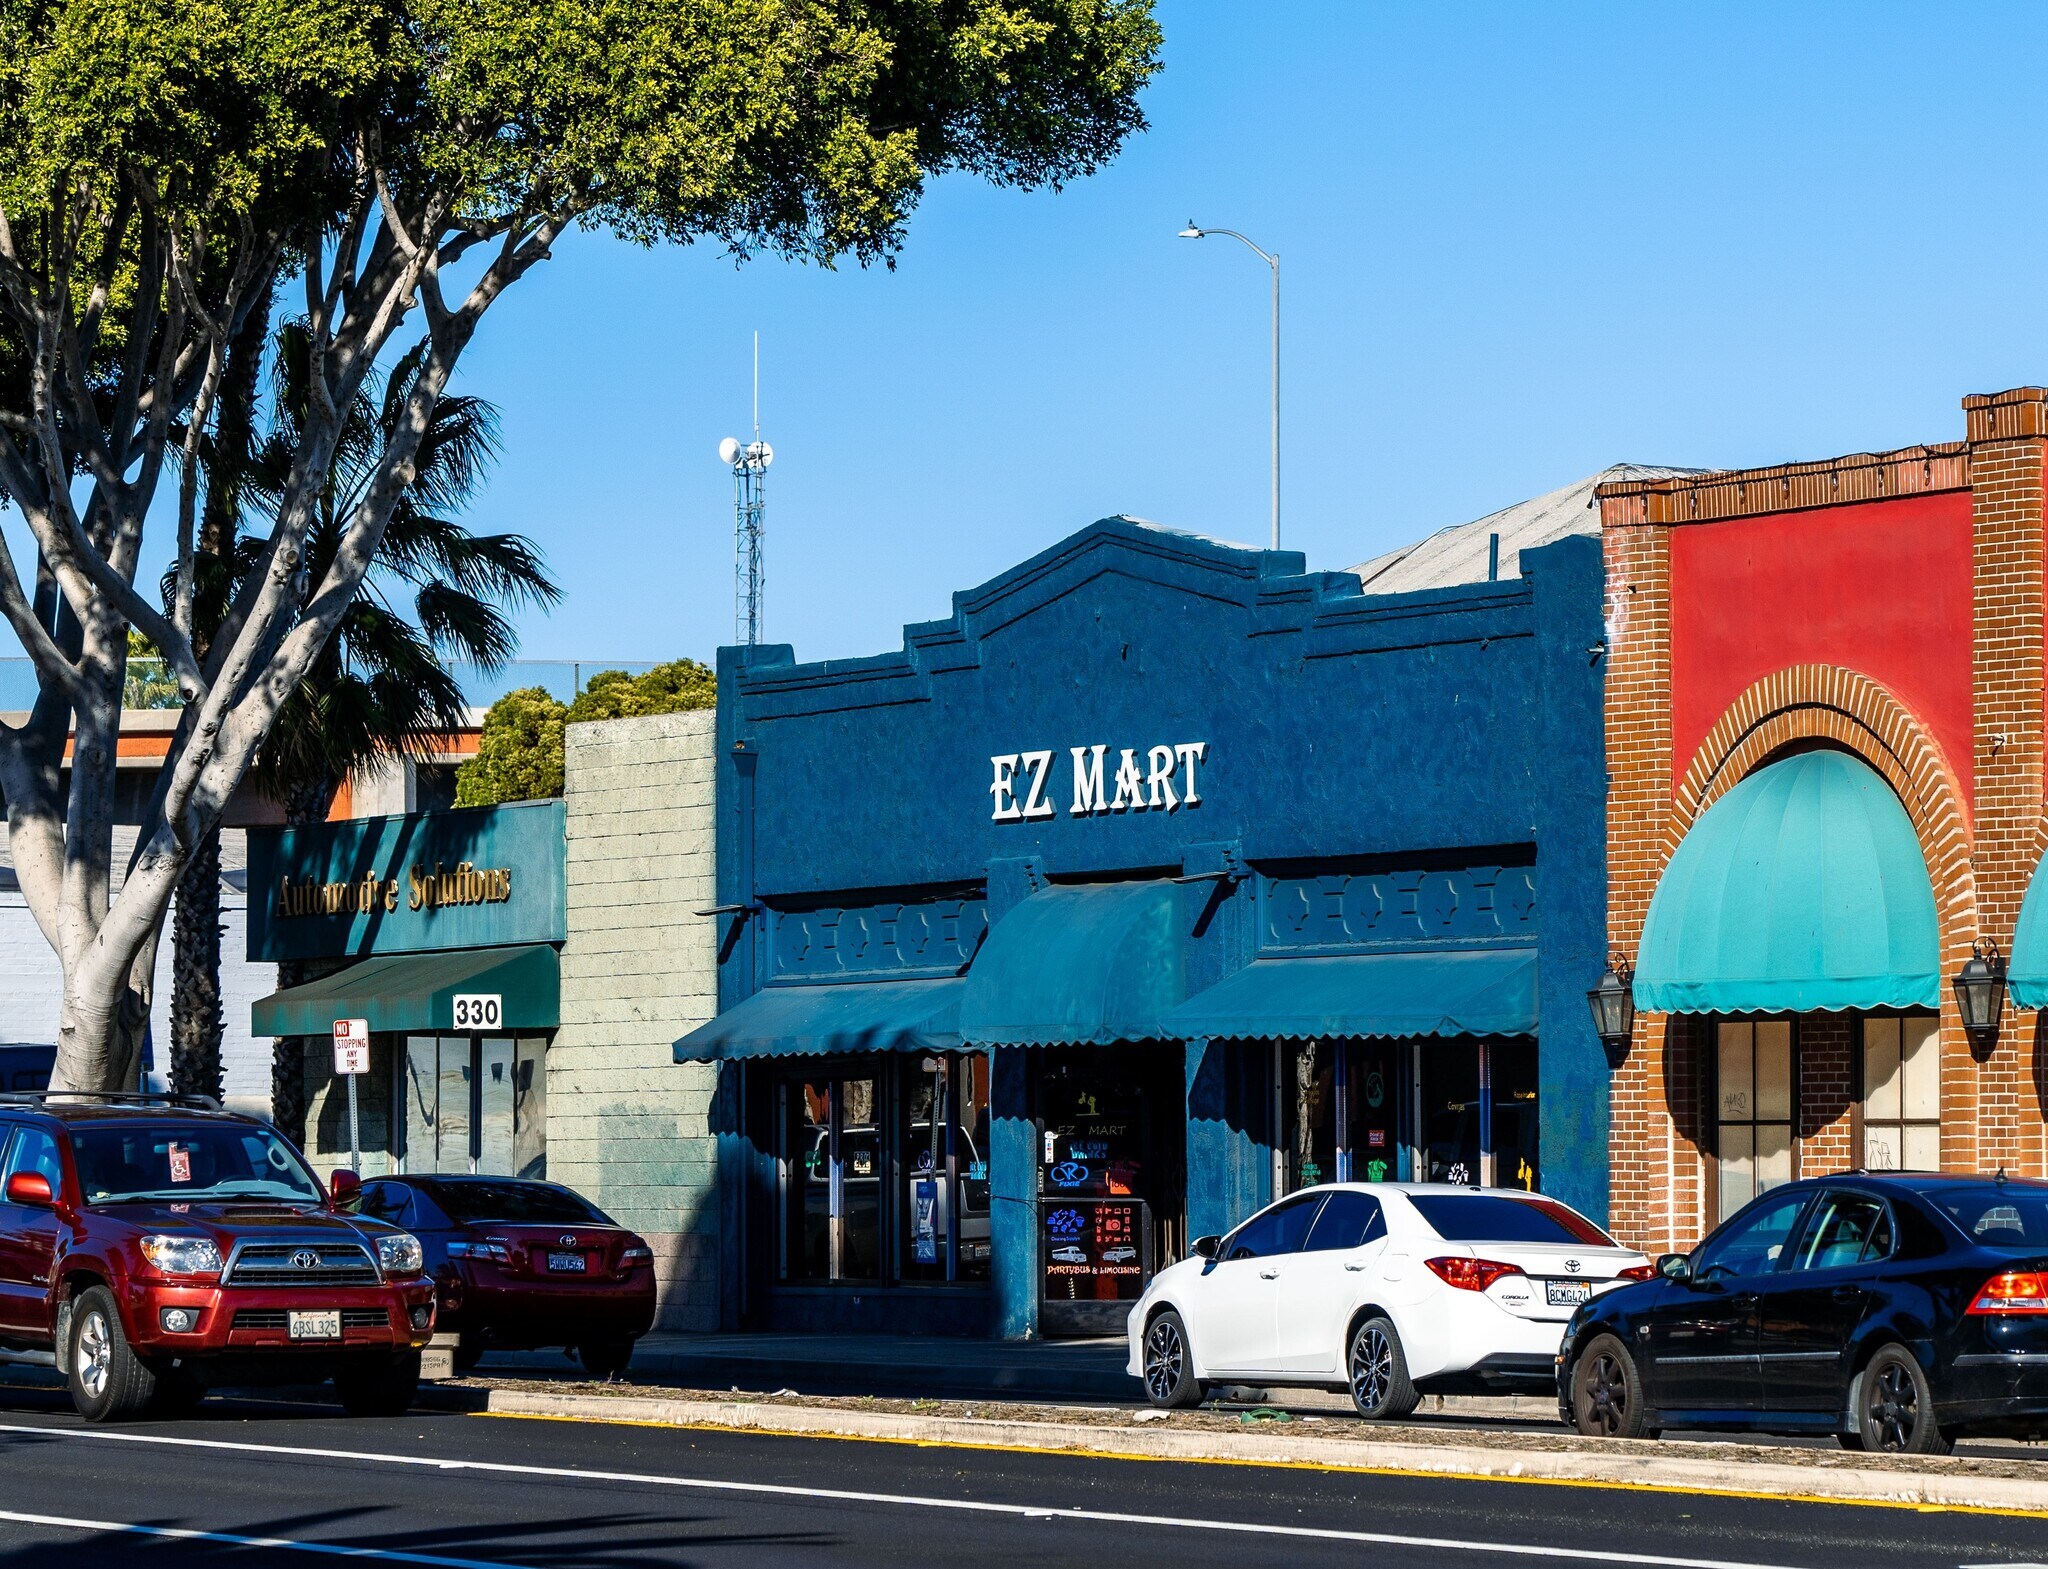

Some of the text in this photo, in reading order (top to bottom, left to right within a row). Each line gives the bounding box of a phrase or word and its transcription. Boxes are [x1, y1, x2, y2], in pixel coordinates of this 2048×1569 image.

[990, 742, 1209, 823] EZ MART
[277, 861, 512, 917] Automotive Solutions
[456, 999, 498, 1025] 330
[336, 1023, 348, 1036] NO
[336, 1038, 366, 1050] STOPPING
[346, 1050, 357, 1058] ANY
[346, 1059, 358, 1067] TIME
[1058, 1125, 1075, 1137] EZ
[1088, 1125, 1127, 1136] MART
[1047, 1265, 1141, 1275] PARTYBUS & LIMOUSINE
[292, 1320, 337, 1335] 6BSL325
